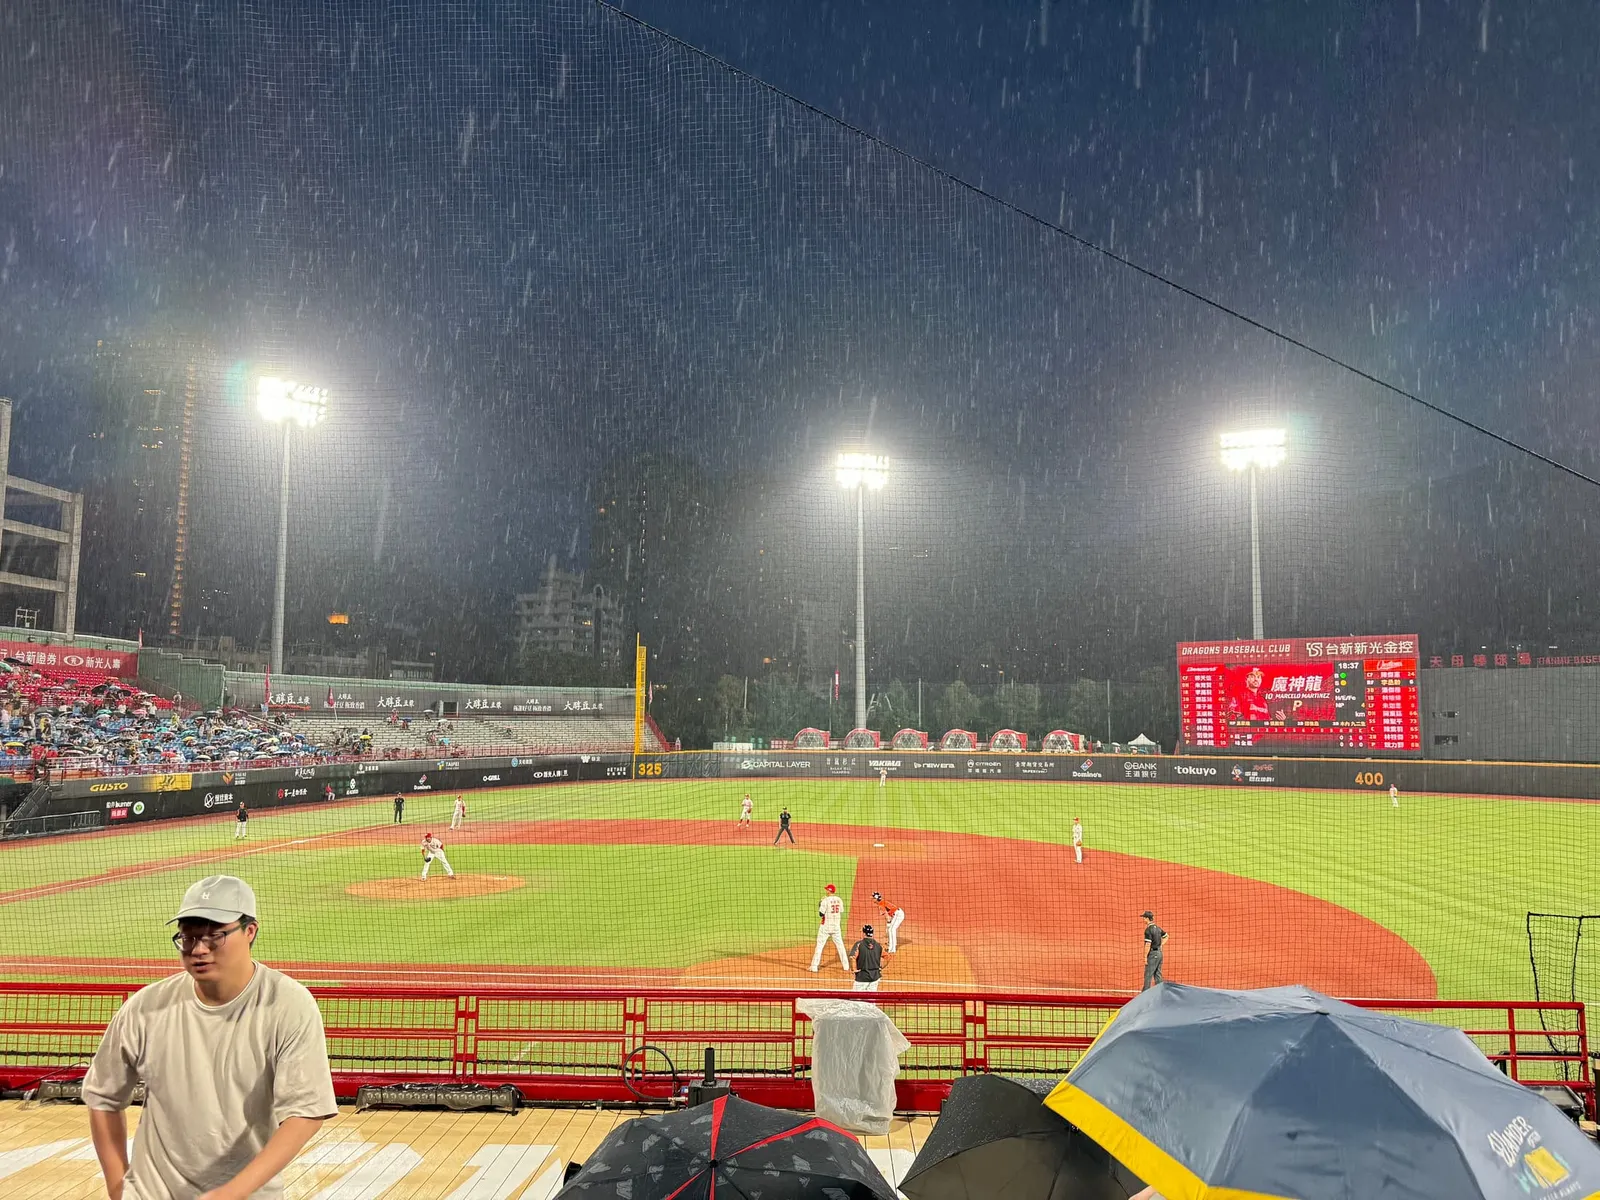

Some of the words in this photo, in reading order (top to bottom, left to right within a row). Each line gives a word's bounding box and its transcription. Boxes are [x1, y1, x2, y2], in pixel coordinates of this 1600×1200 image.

[1182, 647, 1220, 655] DRAGONS
[1222, 645, 1265, 654] BASEBALL
[1268, 644, 1291, 653] CLUB
[1325, 641, 1414, 655] 台新新光金控
[1574, 655, 1600, 664] BASE
[1271, 676, 1322, 692] 魔神龍
[1293, 700, 1303, 711] P
[638, 763, 662, 775] 325
[1125, 770, 1157, 778] 王道銀行
[1176, 766, 1217, 776] tokuyo
[1355, 772, 1384, 785] 400
[90, 782, 129, 791] GUSTO
[1487, 1115, 1533, 1168] WANDER
